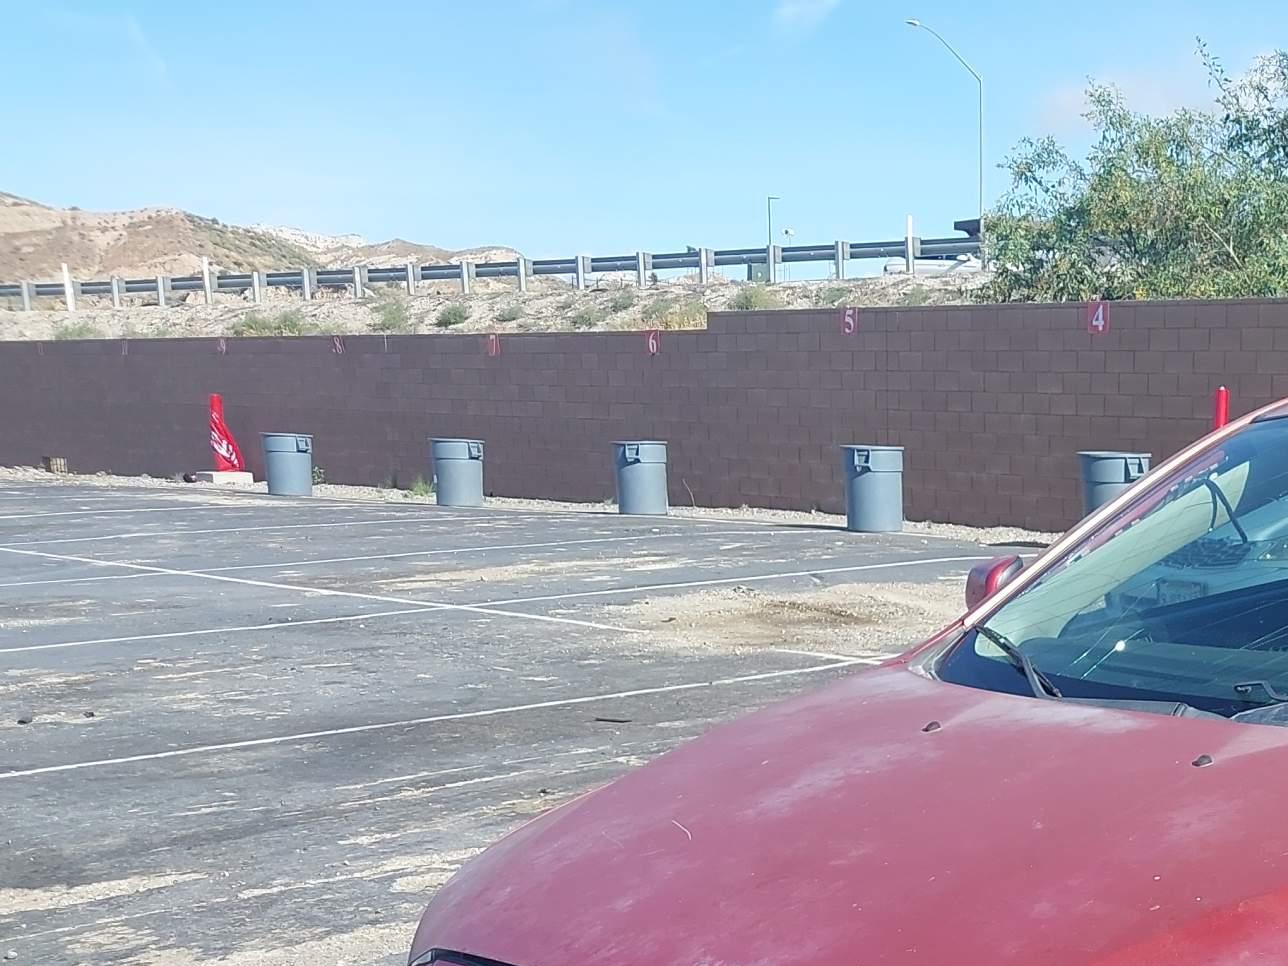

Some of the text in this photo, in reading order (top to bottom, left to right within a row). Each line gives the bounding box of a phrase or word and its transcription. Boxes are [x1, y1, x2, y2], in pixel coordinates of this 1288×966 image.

[844, 309, 854, 333] 5
[1092, 304, 1105, 332] 4
[648, 332, 657, 354] 6
